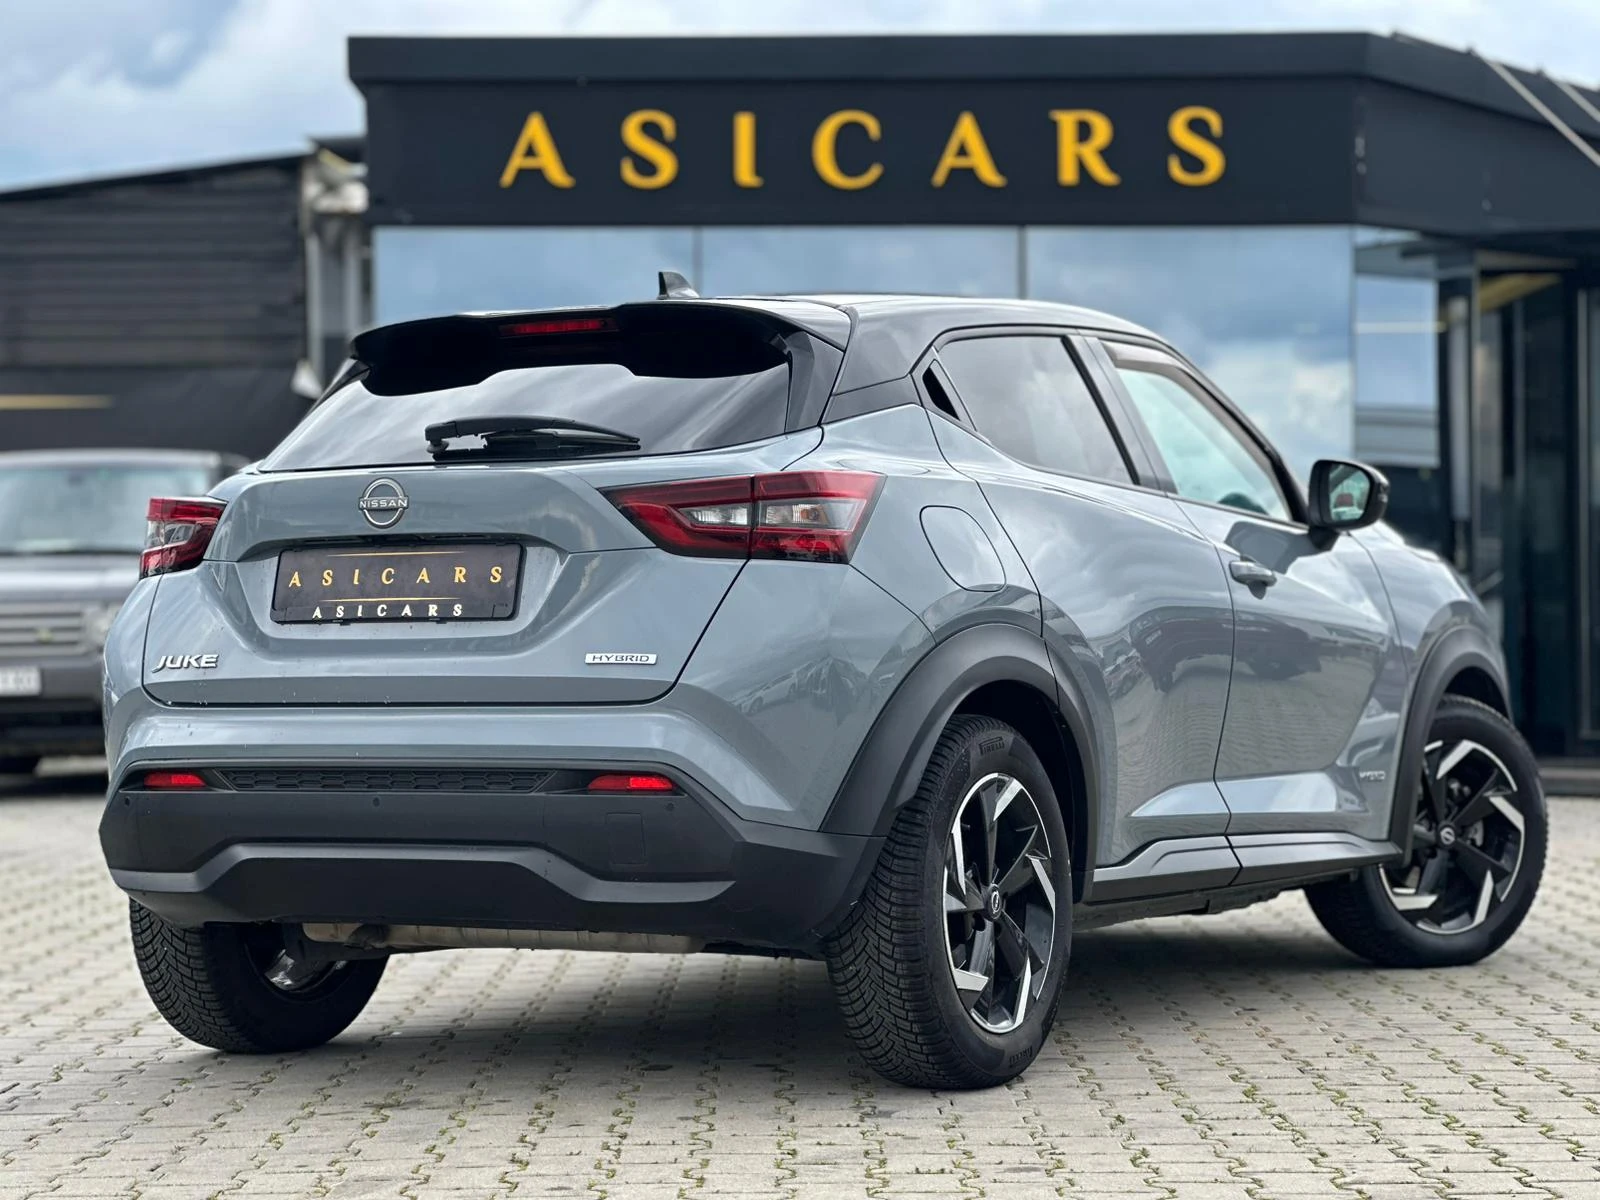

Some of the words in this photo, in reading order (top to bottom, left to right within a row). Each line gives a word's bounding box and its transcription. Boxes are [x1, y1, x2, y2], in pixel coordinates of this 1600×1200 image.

[500, 106, 1226, 190] ASICARS
[360, 499, 407, 508] NISSAN
[289, 566, 502, 588] ASICARS
[312, 604, 463, 619] ASICARS
[152, 654, 218, 673] JUKE
[591, 654, 650, 663] HYBRID
